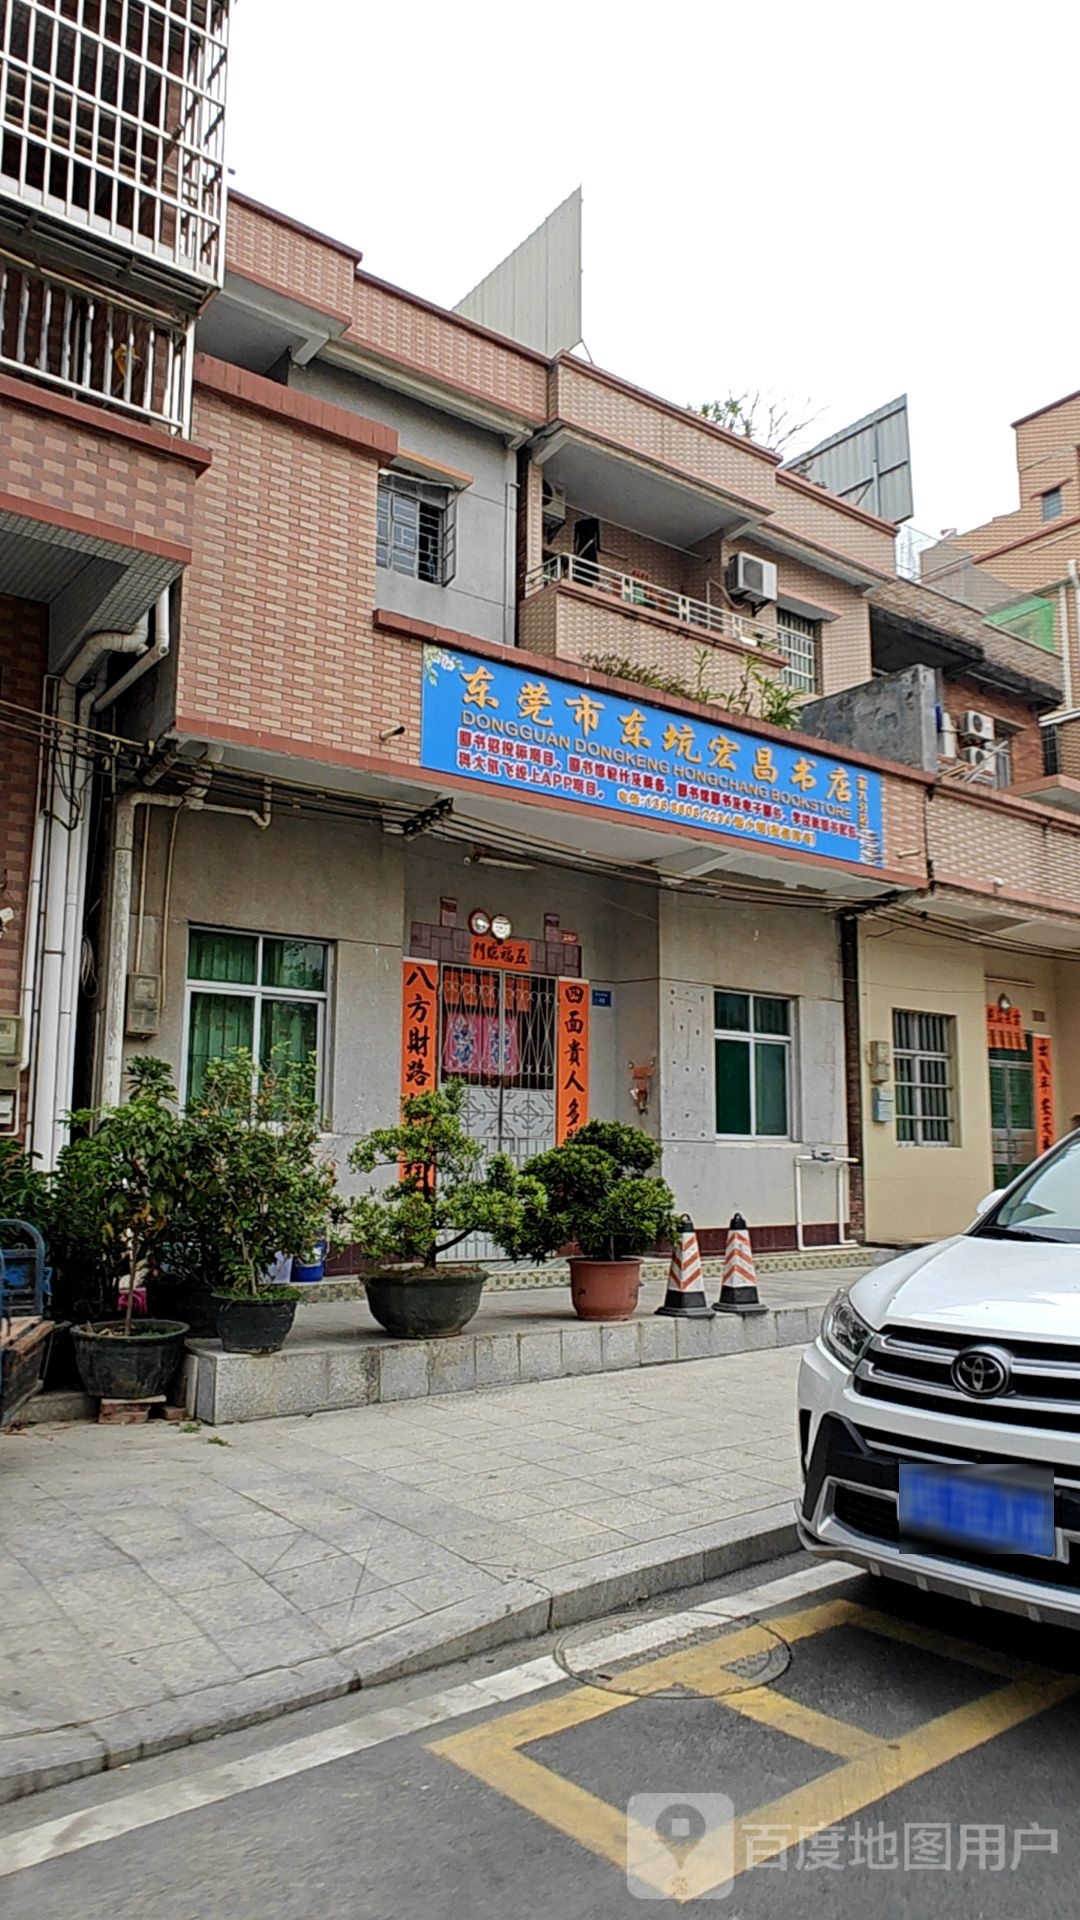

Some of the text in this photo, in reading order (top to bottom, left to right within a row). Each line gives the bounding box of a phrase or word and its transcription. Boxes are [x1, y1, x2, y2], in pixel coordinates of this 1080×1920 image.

[461, 665, 853, 803] 东莞市东坑宏昌书店
[461, 710, 853, 820] DONGGUAN DONGKENG HONGCHANG BOOKSTORE
[405, 965, 436, 1118] 八方財路
